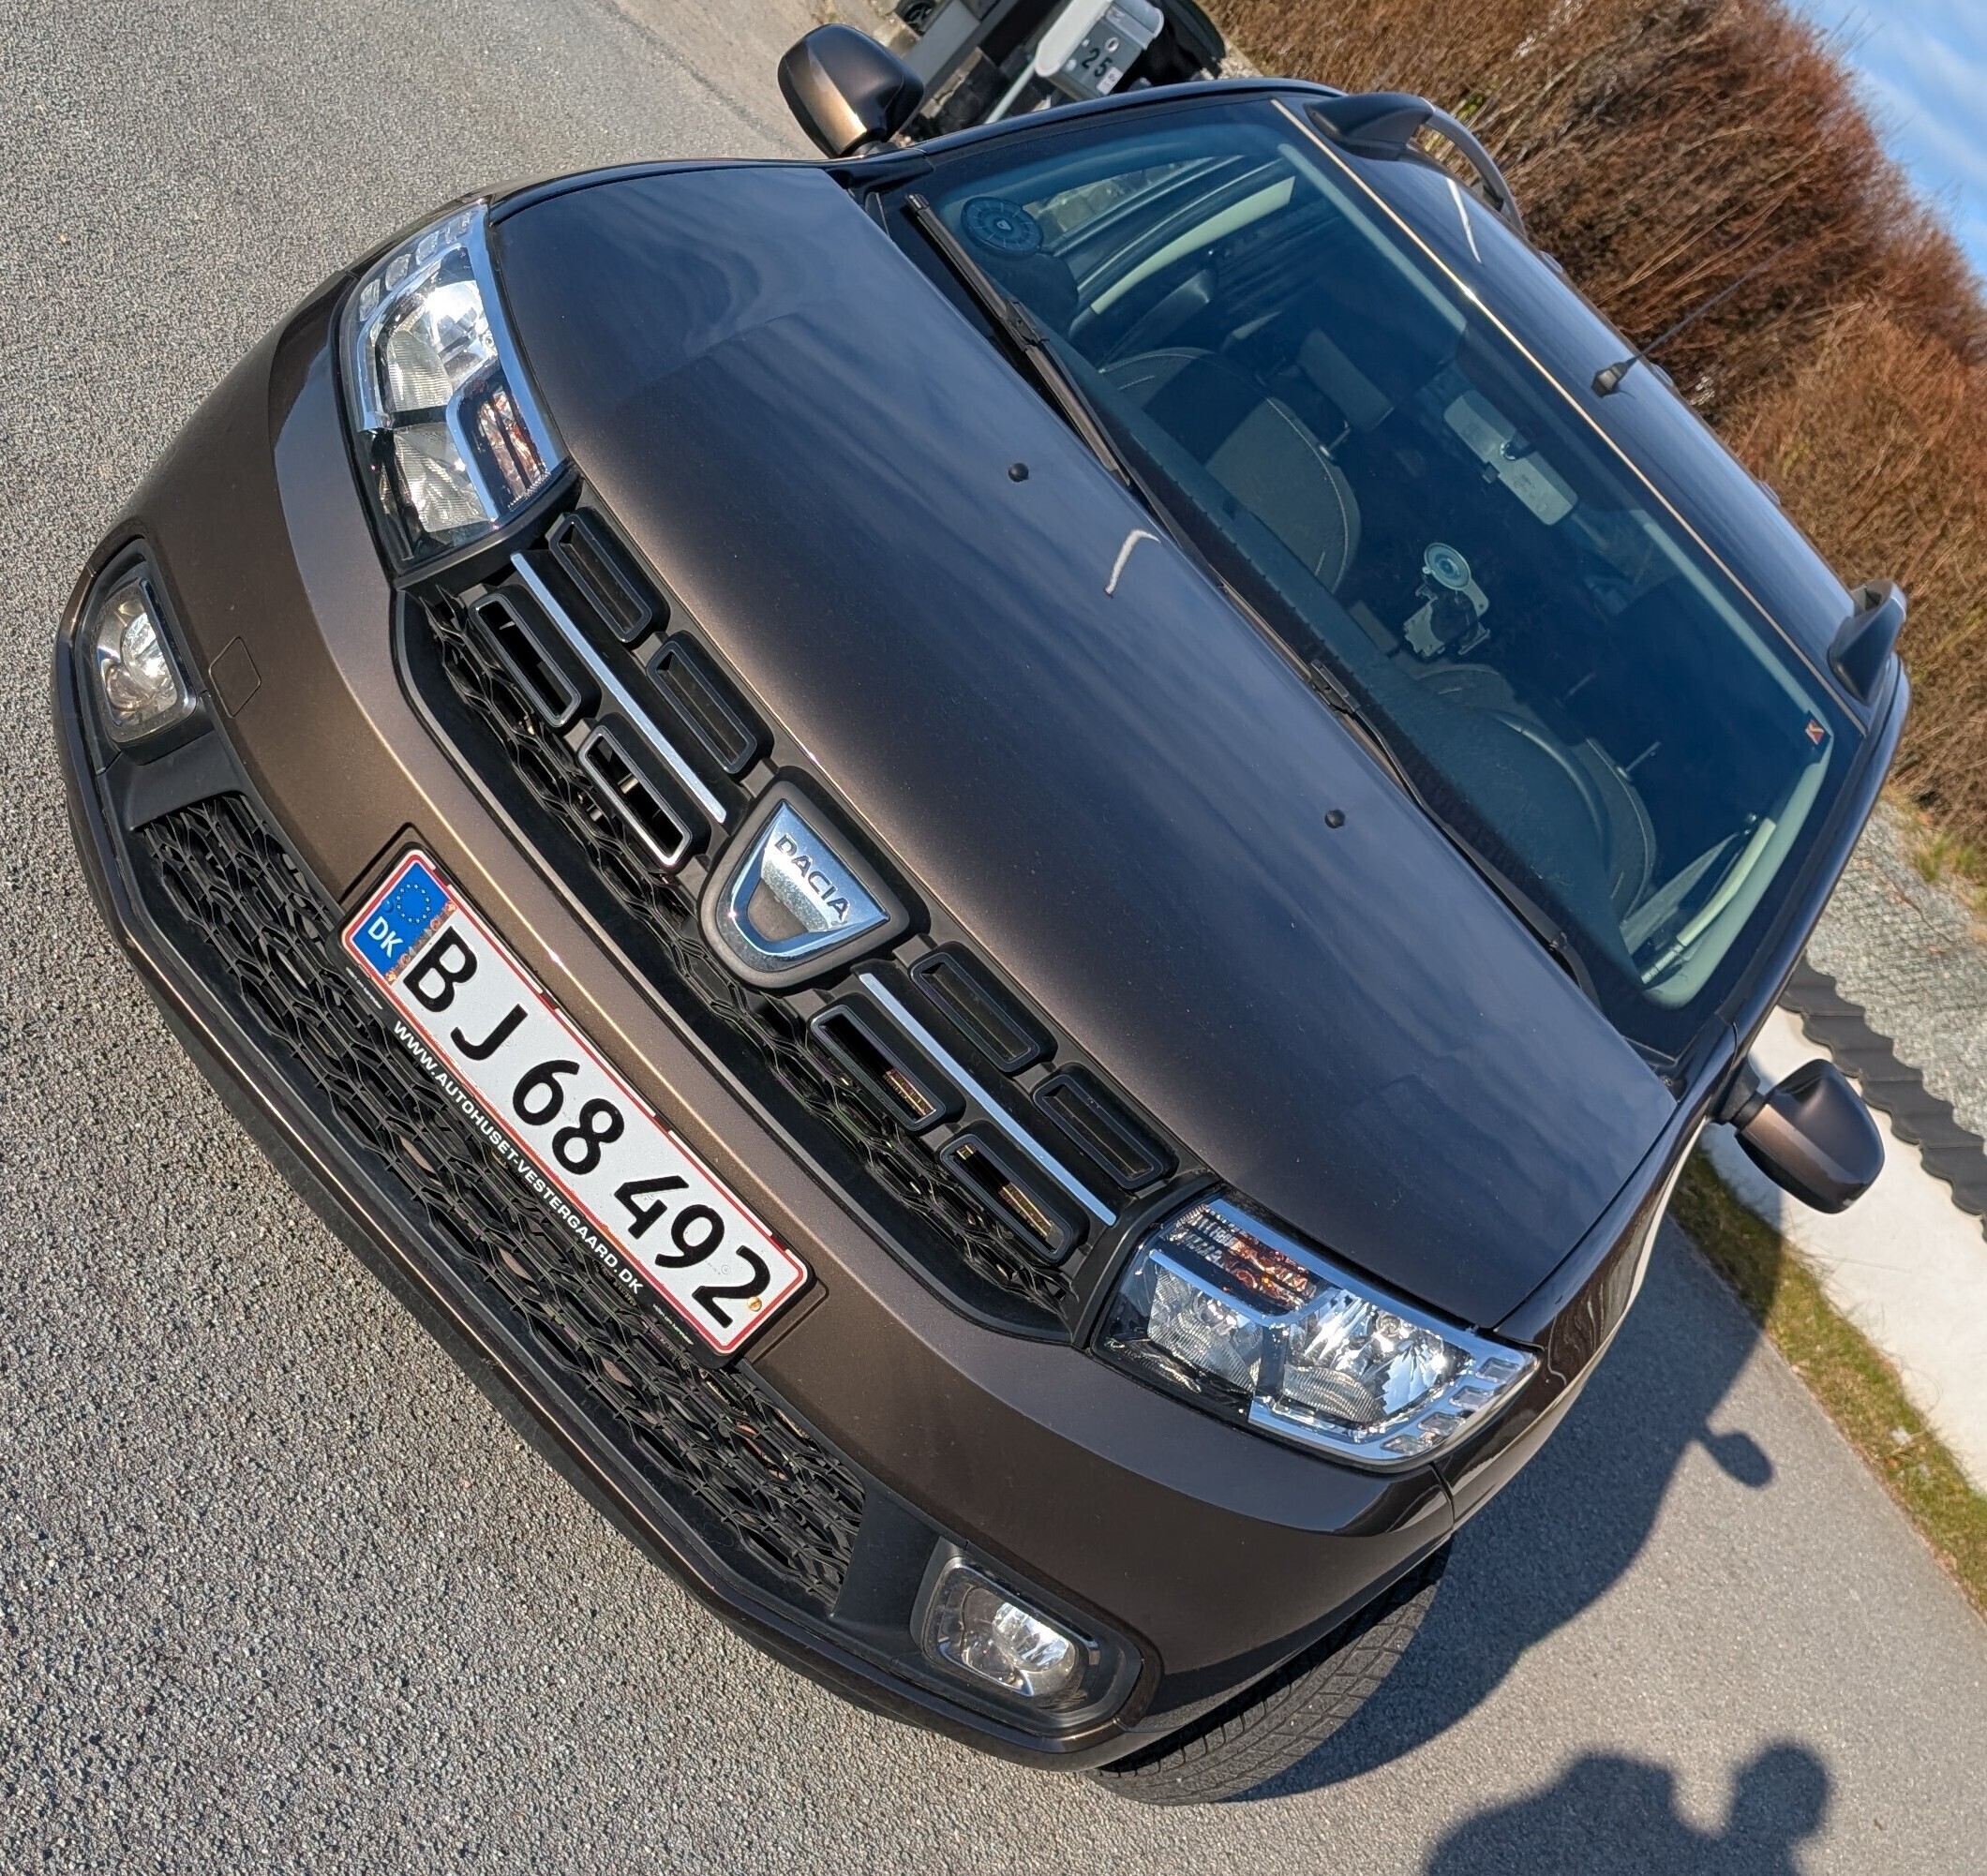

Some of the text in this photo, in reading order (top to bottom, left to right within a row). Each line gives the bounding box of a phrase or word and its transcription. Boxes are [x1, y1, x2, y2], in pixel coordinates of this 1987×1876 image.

[1081, 47, 1113, 78] 25
[774, 833, 850, 921] DACIA
[367, 916, 403, 958] DK
[394, 1020, 644, 1295] WWW.AUTOHUSET-VESTERGAARD.DK
[403, 926, 770, 1329] BJ 68 492
